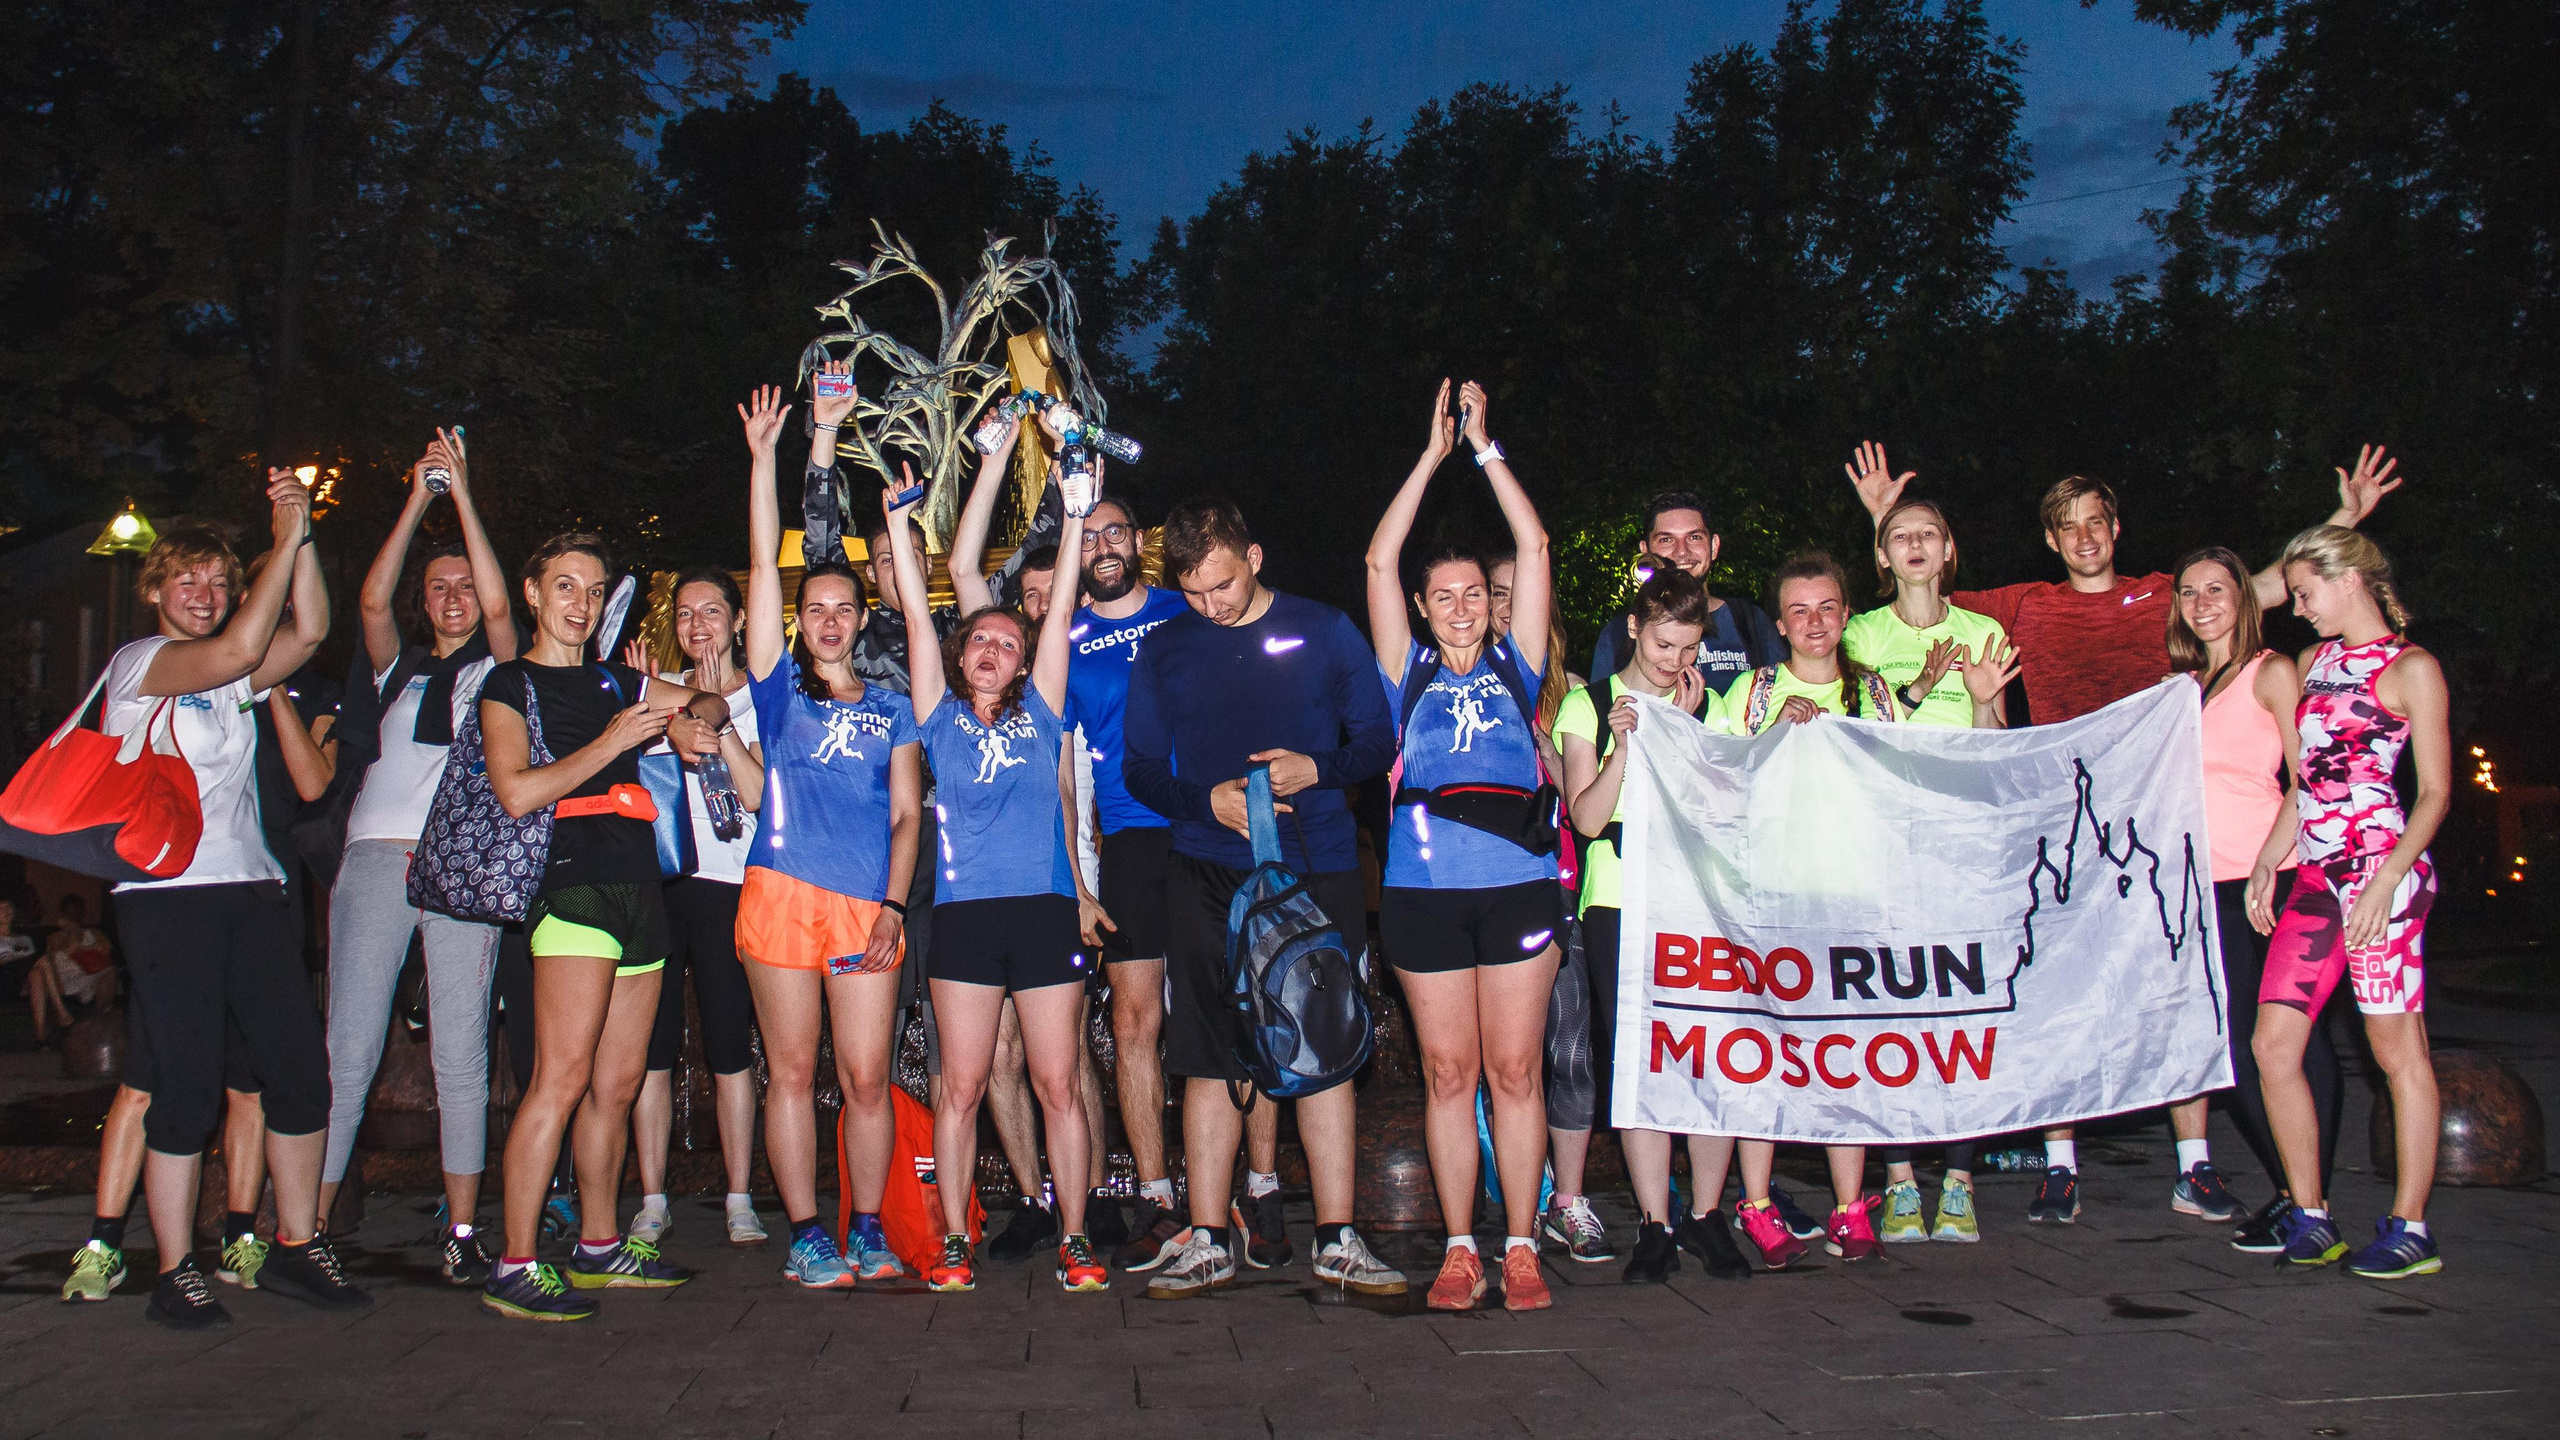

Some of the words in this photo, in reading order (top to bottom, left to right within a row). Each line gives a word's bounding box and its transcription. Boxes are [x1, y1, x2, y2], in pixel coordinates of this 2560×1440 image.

[1697, 649, 1747, 664] ablished
[1711, 662, 1735, 671] since
[862, 723, 890, 742] run
[1008, 726, 1038, 740] run
[1653, 932, 1814, 1002] BBDO
[1828, 942, 1986, 1001] RUN
[1650, 1019, 1998, 1090] MOSCOW
